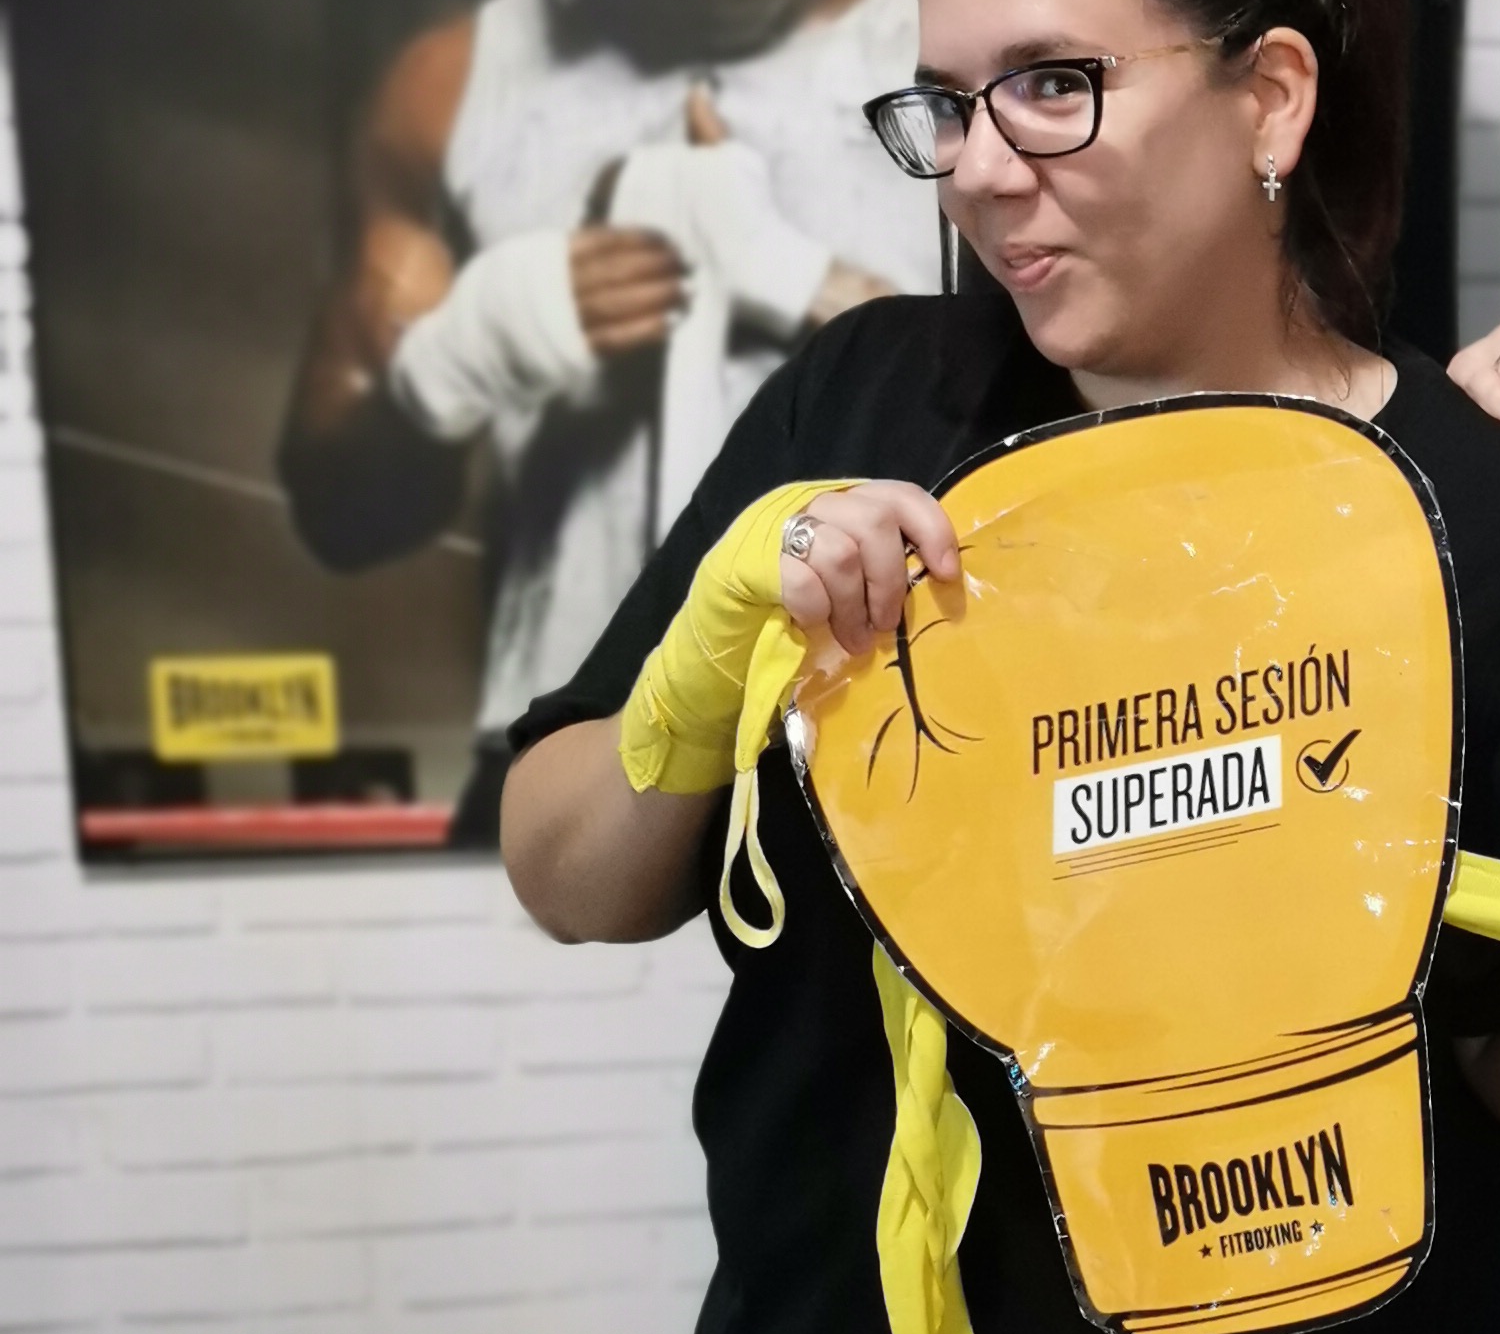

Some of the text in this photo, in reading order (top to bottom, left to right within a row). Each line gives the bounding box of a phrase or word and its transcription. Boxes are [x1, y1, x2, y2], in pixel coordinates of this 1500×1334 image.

[1032, 643, 1351, 775] PRIMERA SESIÓN
[1070, 746, 1272, 845] SUPERADA
[1147, 1122, 1355, 1248] BROOKLYN
[1219, 1219, 1304, 1259] FITBOXING
